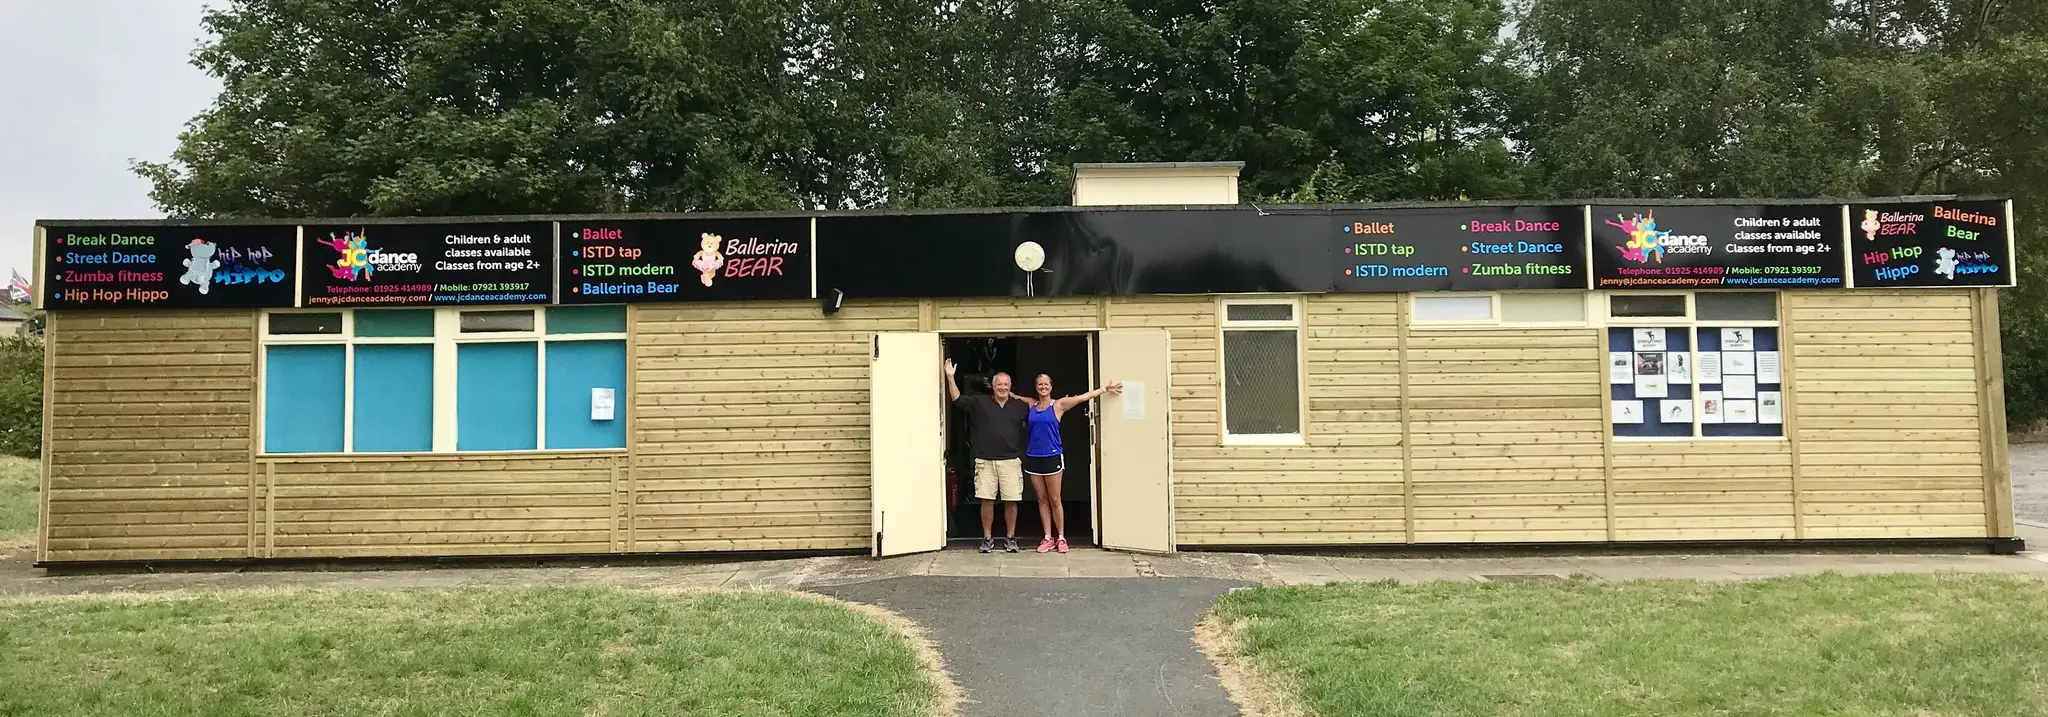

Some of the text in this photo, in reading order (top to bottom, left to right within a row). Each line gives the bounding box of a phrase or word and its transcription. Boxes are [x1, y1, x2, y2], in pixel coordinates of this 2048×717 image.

[1734, 217, 1821, 227] Children & adult
[1880, 212, 1924, 223] Ballerina
[1934, 206, 1996, 226] Ballerina
[1355, 222, 1394, 234] Ballet
[1471, 220, 1560, 232] Break Dance
[1880, 223, 1916, 235] BEAR
[445, 234, 531, 244] Children & adult
[583, 229, 622, 240] Ballet
[1735, 231, 1821, 240] classes available
[1947, 225, 1980, 241] Bear
[67, 234, 155, 246] Break Dance
[1629, 231, 1708, 248] JC dance
[725, 238, 798, 255] Ballerina
[1355, 244, 1414, 257] ISTD tap
[1471, 242, 1563, 254] Street Dance
[1668, 245, 1713, 255] academy
[1726, 244, 1831, 256] Classes from age 2+
[66, 252, 156, 264] Street Dance
[339, 248, 418, 267] JC dance
[445, 248, 531, 258] classes available
[583, 247, 642, 259] ISTD tap
[1864, 246, 1923, 265] Hip Hop
[377, 262, 422, 273] academy
[435, 260, 540, 272] Classes from age 2+
[583, 265, 674, 276] ISTD modern
[724, 257, 783, 278] BEAR
[1355, 265, 1448, 277] ISTD modern
[1472, 262, 1572, 275] Zumba fitness
[1618, 268, 1663, 276] Telephone:
[1665, 267, 1691, 275] 01925
[1764, 266, 1790, 274] 07921
[1792, 266, 1822, 274] 393917
[1875, 264, 1919, 280] Hippo
[65, 270, 163, 282] Zumba fitness
[1600, 277, 1719, 286] jenny@jcdanceacademy.com
[1727, 276, 1839, 284] www.jcdanceacademy.com
[327, 285, 372, 293] Telephone:
[374, 285, 399, 293] 01925
[434, 284, 437, 292] /
[440, 284, 470, 292] Mobile:
[472, 283, 497, 291] 07921
[583, 282, 679, 295] Ballerina Bear
[64, 289, 169, 303] Hip Hop Hippo
[308, 294, 427, 304] jenny@jcdanceacademy.com
[435, 292, 546, 301] www.jcdanceacademy.com
